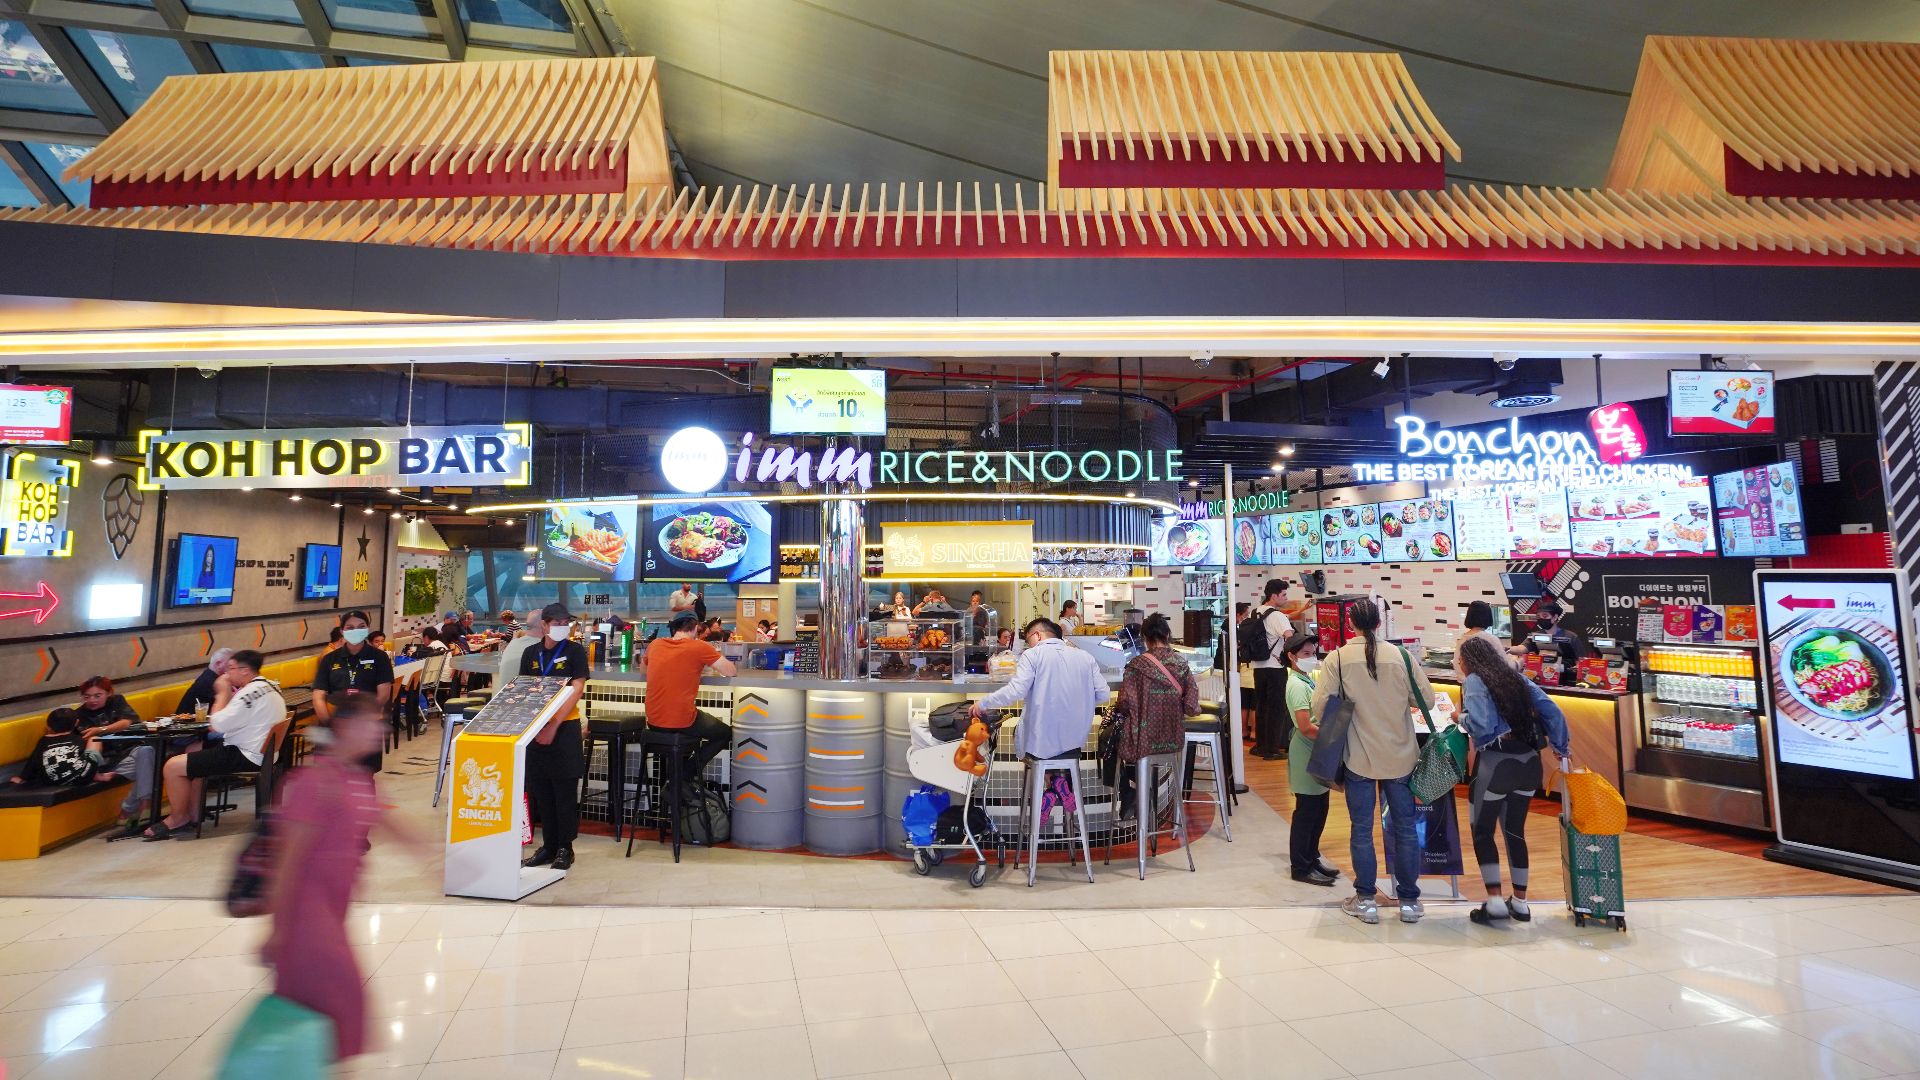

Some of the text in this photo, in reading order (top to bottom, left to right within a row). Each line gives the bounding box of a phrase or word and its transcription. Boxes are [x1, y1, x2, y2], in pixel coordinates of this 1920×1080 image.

[1395, 415, 1593, 457] Bonchon
[152, 435, 507, 477] KOH HOP BAR
[735, 431, 1184, 489] imm RICE&NOODLE
[1352, 463, 1395, 481] THE
[1397, 463, 1450, 481] BEST
[20, 481, 59, 503] KOH
[19, 502, 59, 522] HOP
[1208, 490, 1289, 516] RIC&NOODLE
[17, 522, 55, 543] BAR
[931, 542, 1030, 563] SINGHA
[1607, 595, 1703, 608] BONHON
[458, 808, 503, 821] SINGHA
